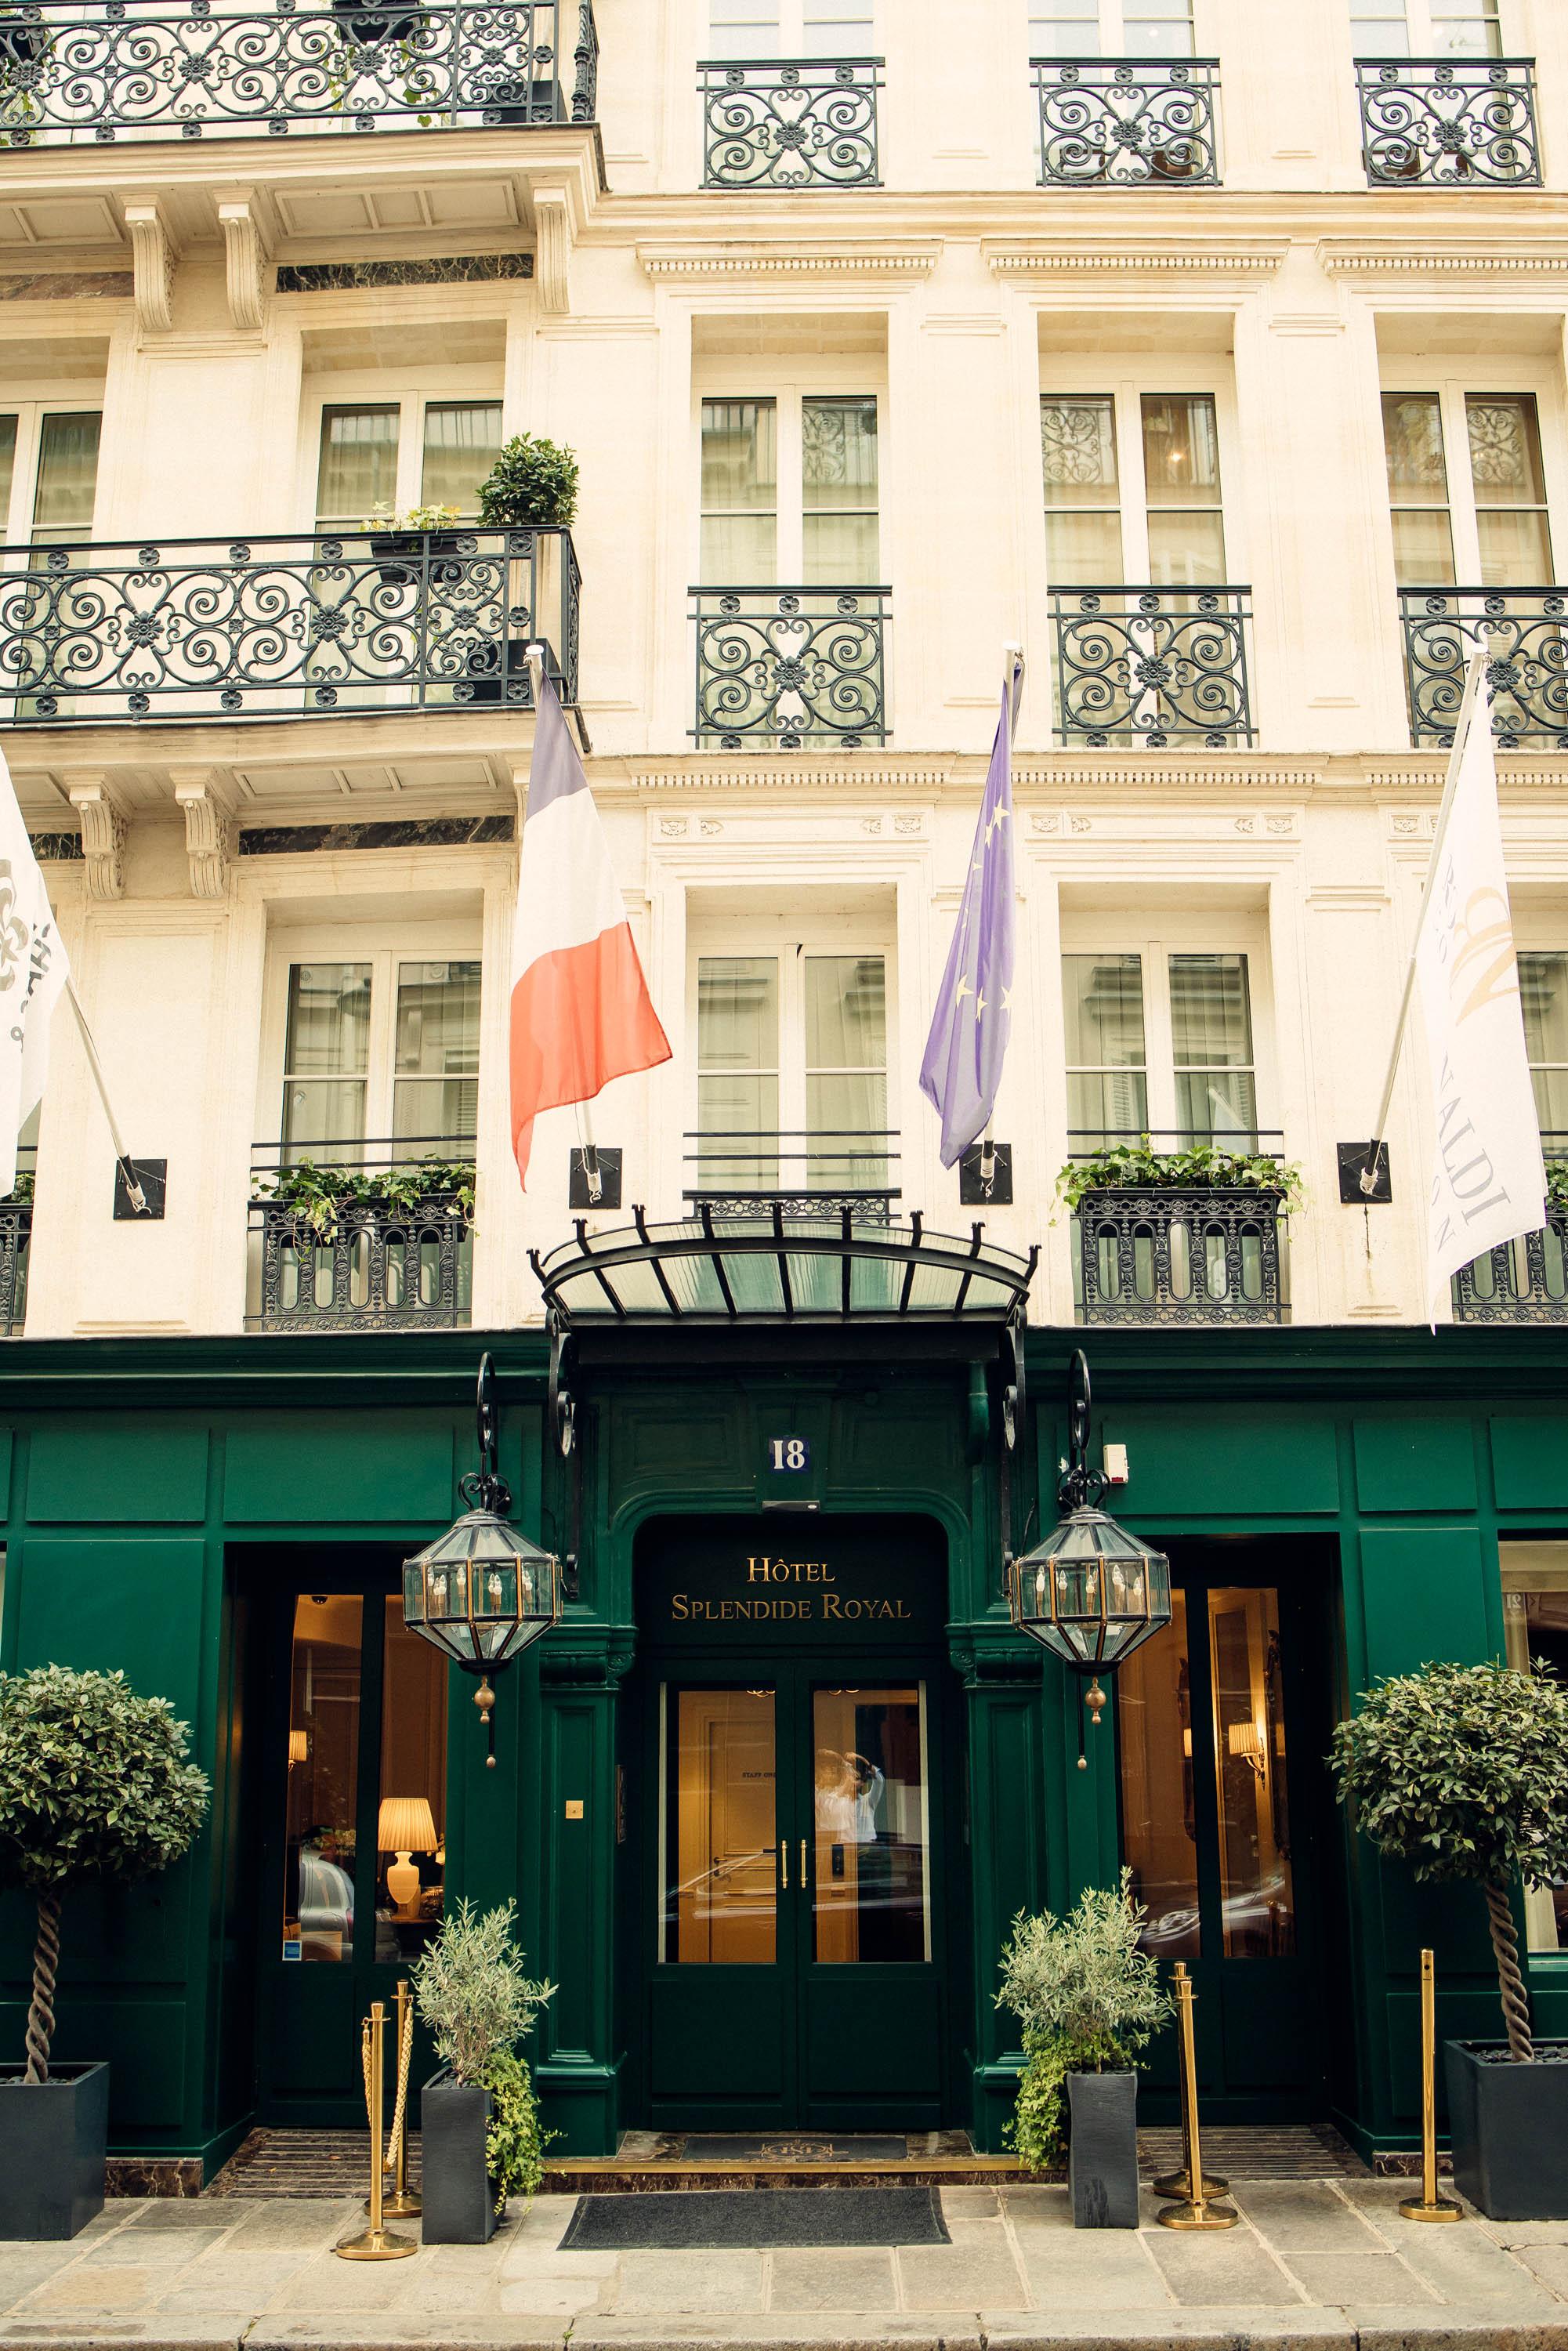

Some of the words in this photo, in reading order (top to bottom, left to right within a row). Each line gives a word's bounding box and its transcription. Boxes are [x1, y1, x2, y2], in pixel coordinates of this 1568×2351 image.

[773, 1440, 805, 1469] 18
[672, 1594, 812, 1620] SPLENDIDE
[820, 1594, 911, 1619] ROYAL
